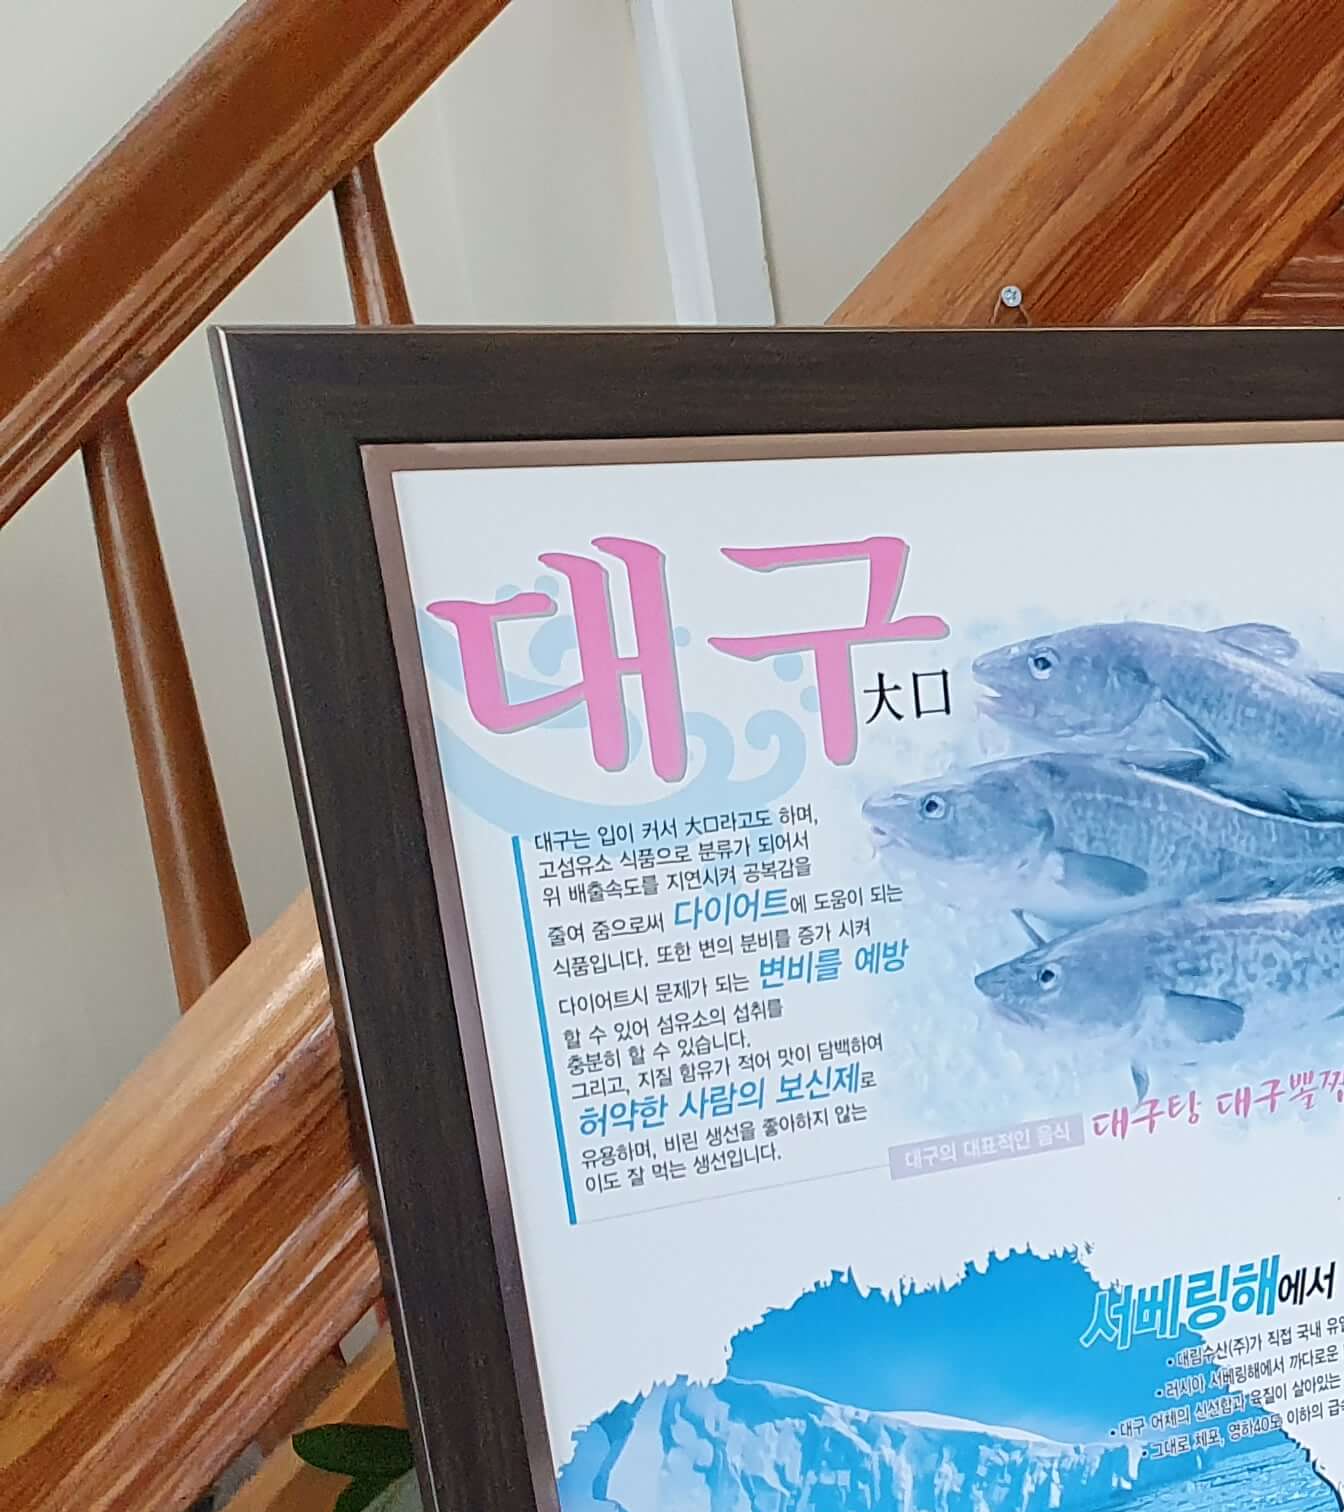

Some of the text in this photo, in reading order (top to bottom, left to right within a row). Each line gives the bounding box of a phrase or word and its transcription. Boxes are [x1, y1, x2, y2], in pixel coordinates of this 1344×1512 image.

[426, 536, 952, 783] 대구 大口
[535, 829, 591, 853] 대구는
[597, 822, 634, 847] 입이
[641, 817, 678, 840] 커서
[778, 803, 818, 826] 하며,
[538, 830, 809, 879] 고섬유소 식품으로 분류가 되어서
[543, 856, 811, 908] 위 배출속도를 지연시켜 공복감을
[548, 883, 903, 947] 줄여 줌으로써 다이어트에 도움이 되는
[553, 947, 649, 978] 식품입니다.
[657, 941, 692, 964] 또한
[740, 928, 791, 953] 분비를
[798, 921, 831, 946] 증가
[839, 916, 871, 939] 시켜
[558, 938, 910, 1016] 다이어트시 문제가 되는 변비를 예방
[564, 998, 783, 1050] 할 수 있어 섬유소의 섭취를
[567, 1028, 751, 1076] 충분히 할 수 있습니다.
[571, 1032, 883, 1100] 그리고, 지질 함유가 적어 맛이 담백하여
[579, 1061, 877, 1137] 허약한 사람의 보신제로
[1091, 1090, 1199, 1140] 대구탕
[582, 1102, 868, 1170] 유용하며, 비린 생선을 좋아하지 않는
[904, 1120, 1071, 1169] 대구의 대표적인 음식
[585, 1141, 782, 1193] 이도 잘 먹는 생선입니다.
[1079, 1254, 1336, 1352] 서베링해에서
[1268, 1326, 1292, 1346] 직접
[1297, 1320, 1321, 1340] 국내
[1166, 1376, 1204, 1398] 러시아
[1211, 1355, 1285, 1388] 서베링해에서
[1289, 1344, 1339, 1370] 까다로운
[1120, 1418, 1145, 1437] 대구
[1152, 1407, 1190, 1430] 어체의
[1251, 1383, 1287, 1406] 육질이
[1292, 1373, 1341, 1398] 살아있는
[1152, 1436, 1190, 1458] 그대로
[1229, 1412, 1283, 1441] 영하40도
[1286, 1401, 1323, 1424] 이하의
